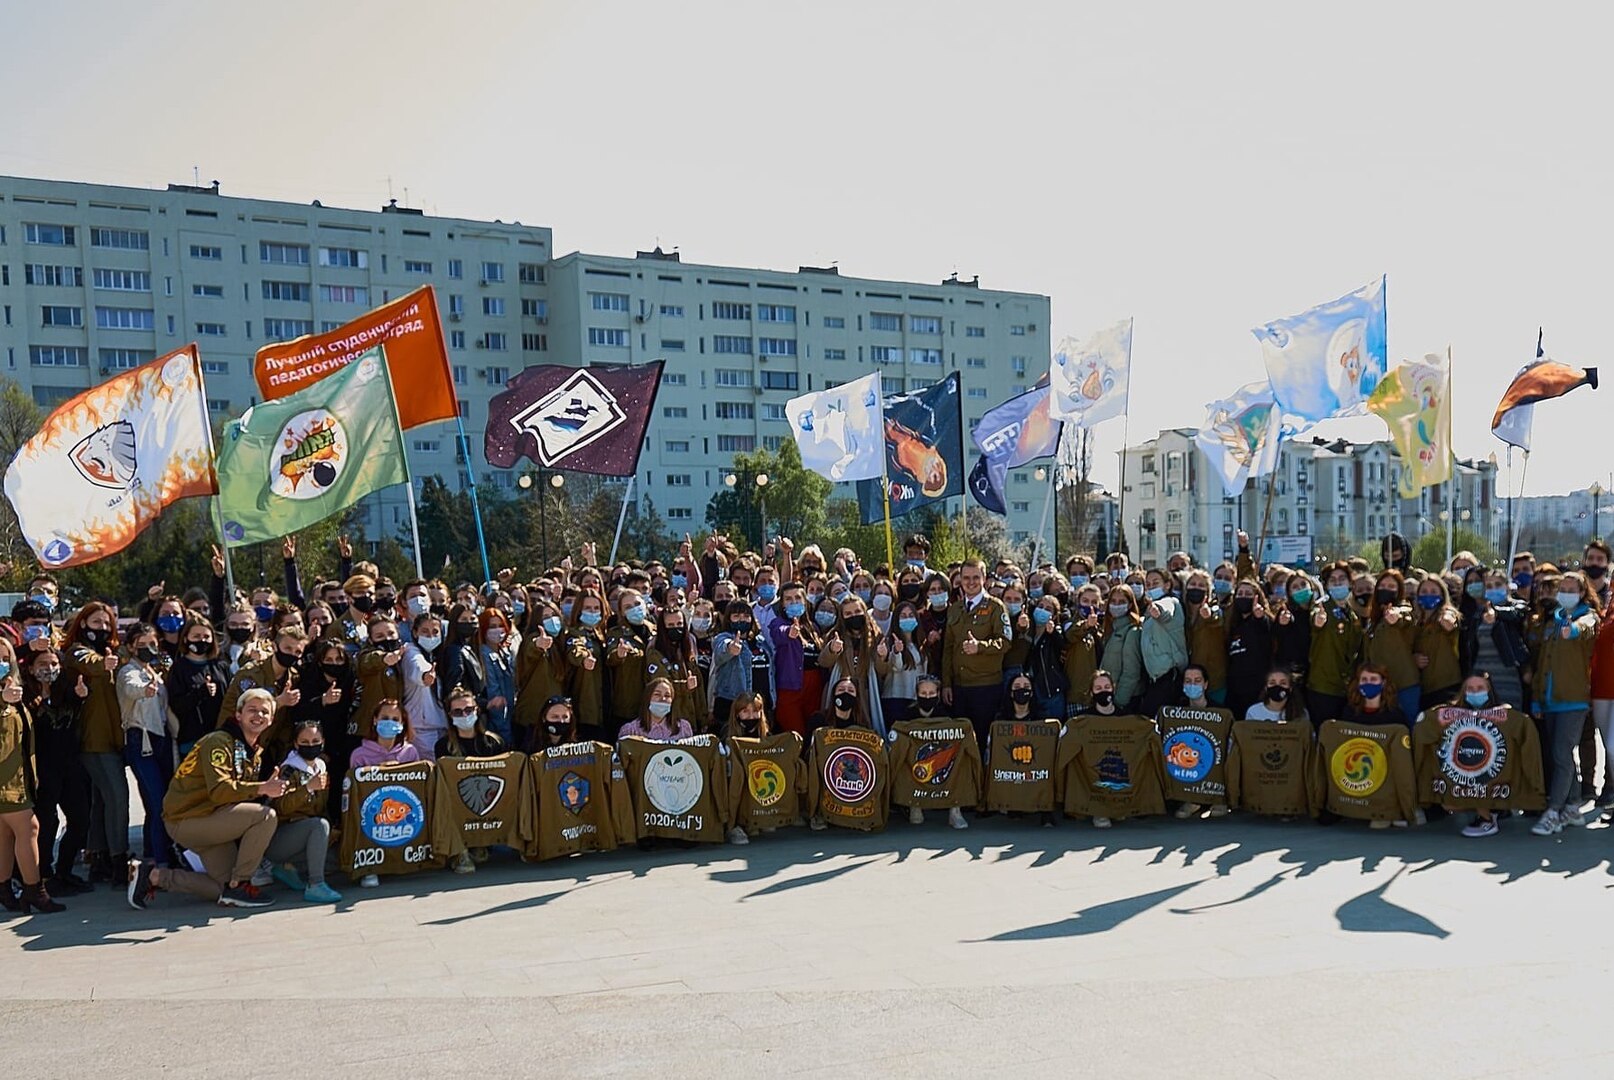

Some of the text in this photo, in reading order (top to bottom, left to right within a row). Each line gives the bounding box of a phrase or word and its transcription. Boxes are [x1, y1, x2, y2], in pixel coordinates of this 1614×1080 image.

[265, 345, 326, 371] Лучший
[269, 319, 425, 387] педагогичес тряд
[355, 766, 427, 782] Севастополь
[1493, 784, 1510, 799] 20
[354, 848, 384, 869] 2020
